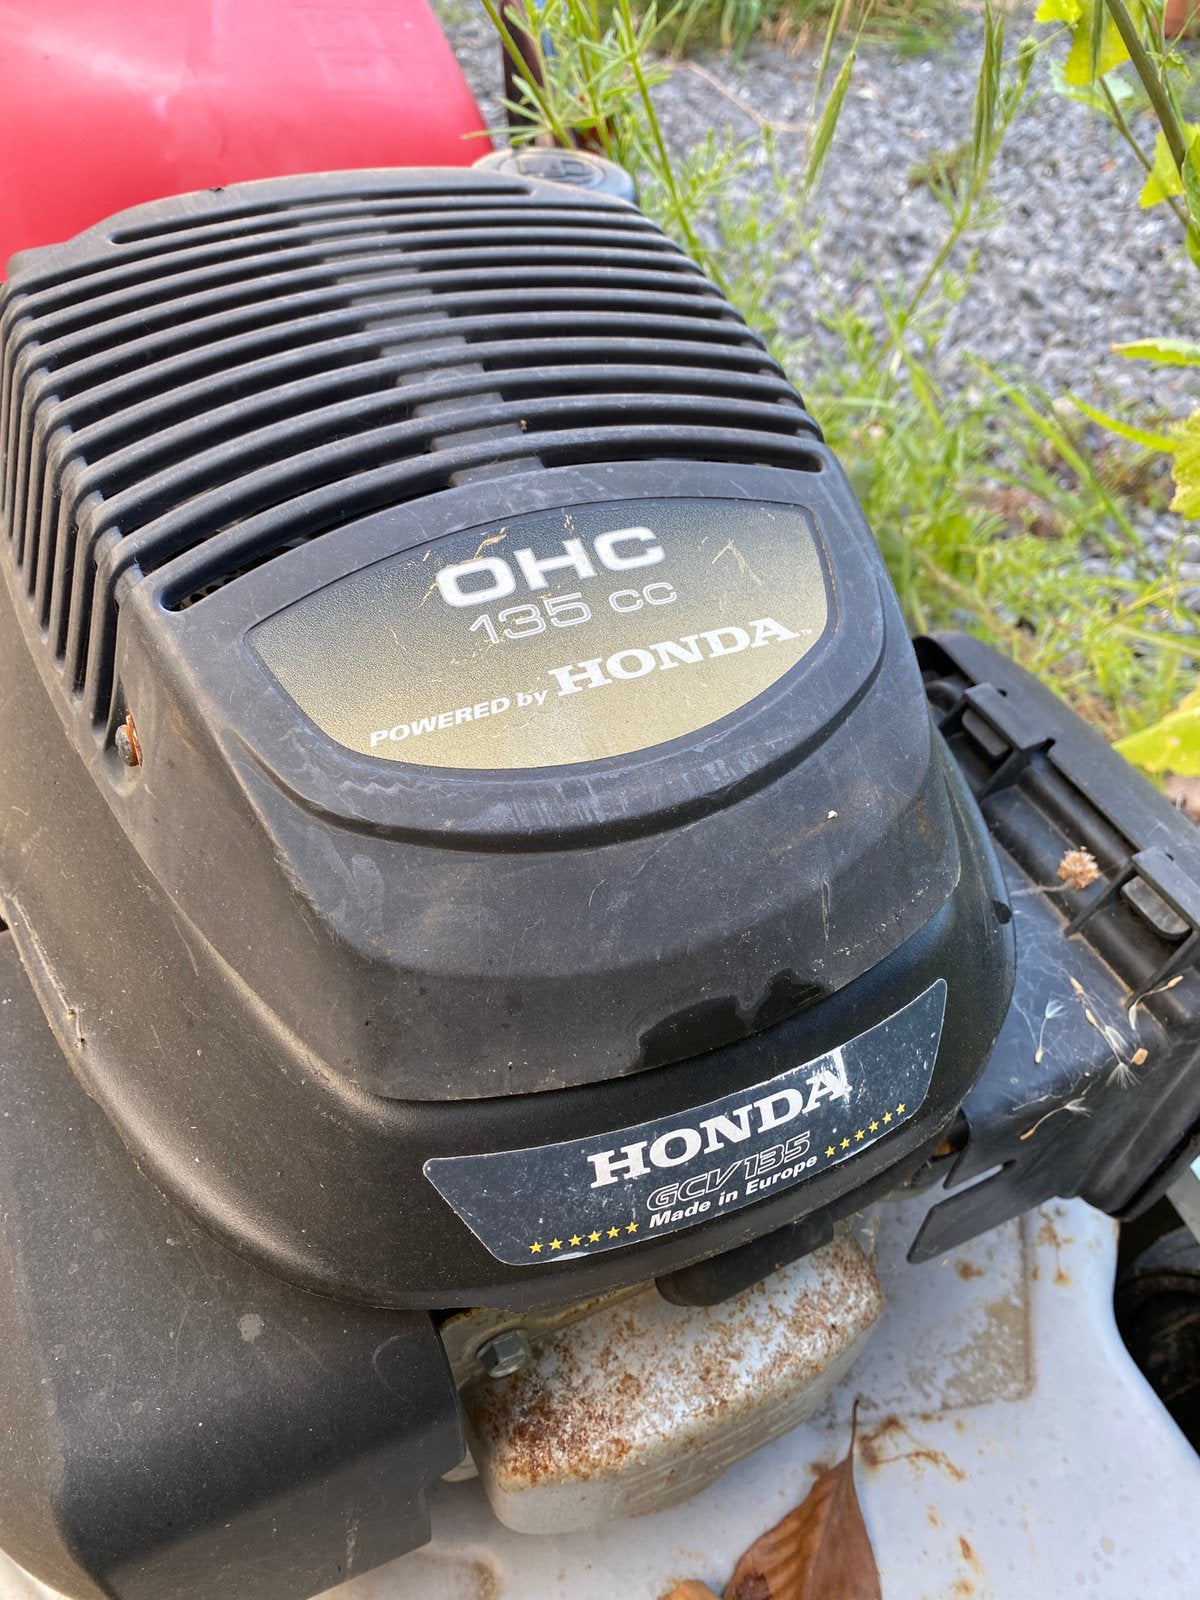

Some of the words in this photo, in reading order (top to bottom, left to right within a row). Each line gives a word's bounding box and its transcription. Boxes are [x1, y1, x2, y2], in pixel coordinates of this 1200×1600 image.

[435, 526, 666, 608] OHC
[469, 592, 592, 645] 135
[369, 698, 510, 748] POWERED
[516, 687, 550, 708] by
[587, 1069, 853, 1189] HONDA
[646, 1130, 812, 1212] GCV135
[648, 1201, 711, 1229] Made
[718, 1189, 739, 1206] in
[745, 1155, 819, 1197] Europe
